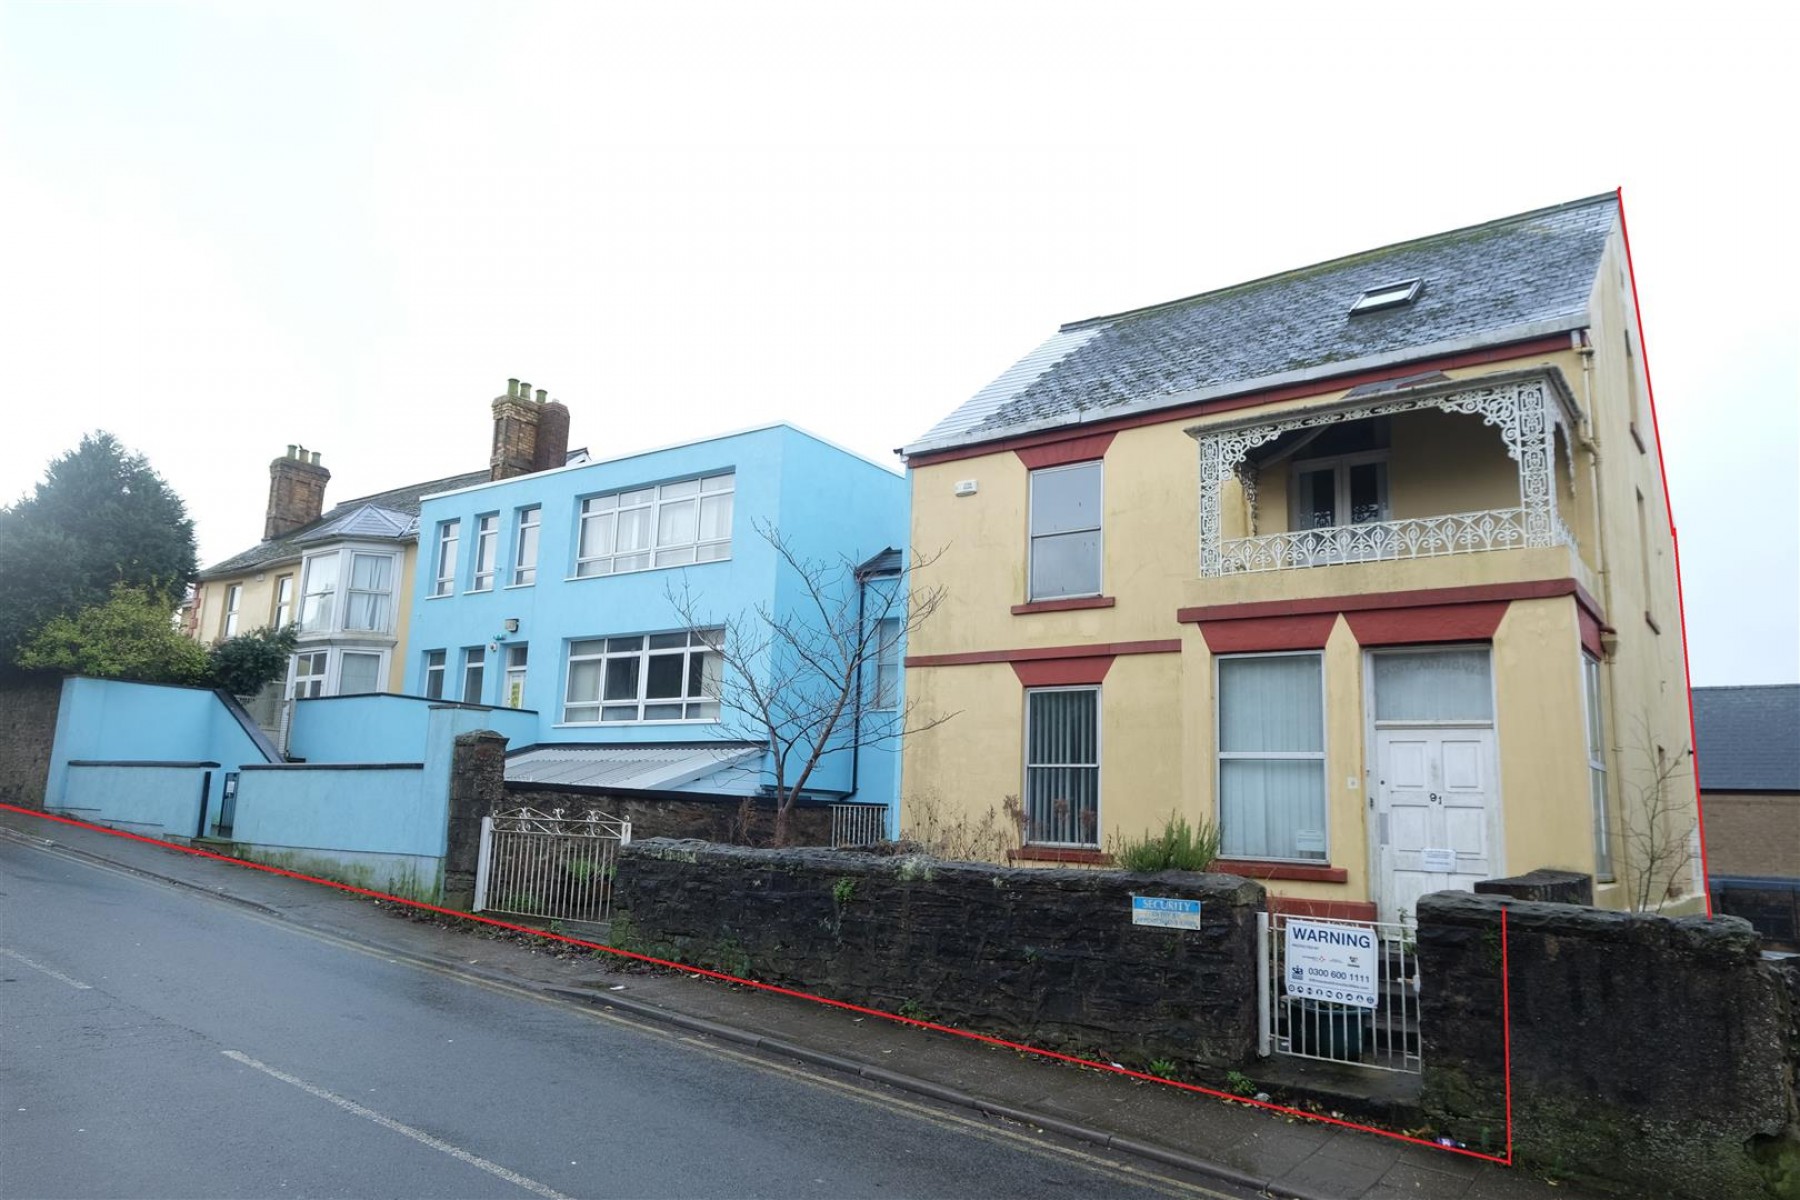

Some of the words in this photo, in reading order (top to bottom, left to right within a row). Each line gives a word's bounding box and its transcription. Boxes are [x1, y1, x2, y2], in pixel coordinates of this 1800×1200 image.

[1430, 793, 1442, 805] 91
[1142, 899, 1191, 911] SECURITY
[1293, 927, 1370, 948] WARNING
[1308, 967, 1328, 977] 0300
[1330, 970, 1347, 980] 600
[1350, 974, 1369, 983] 1111
